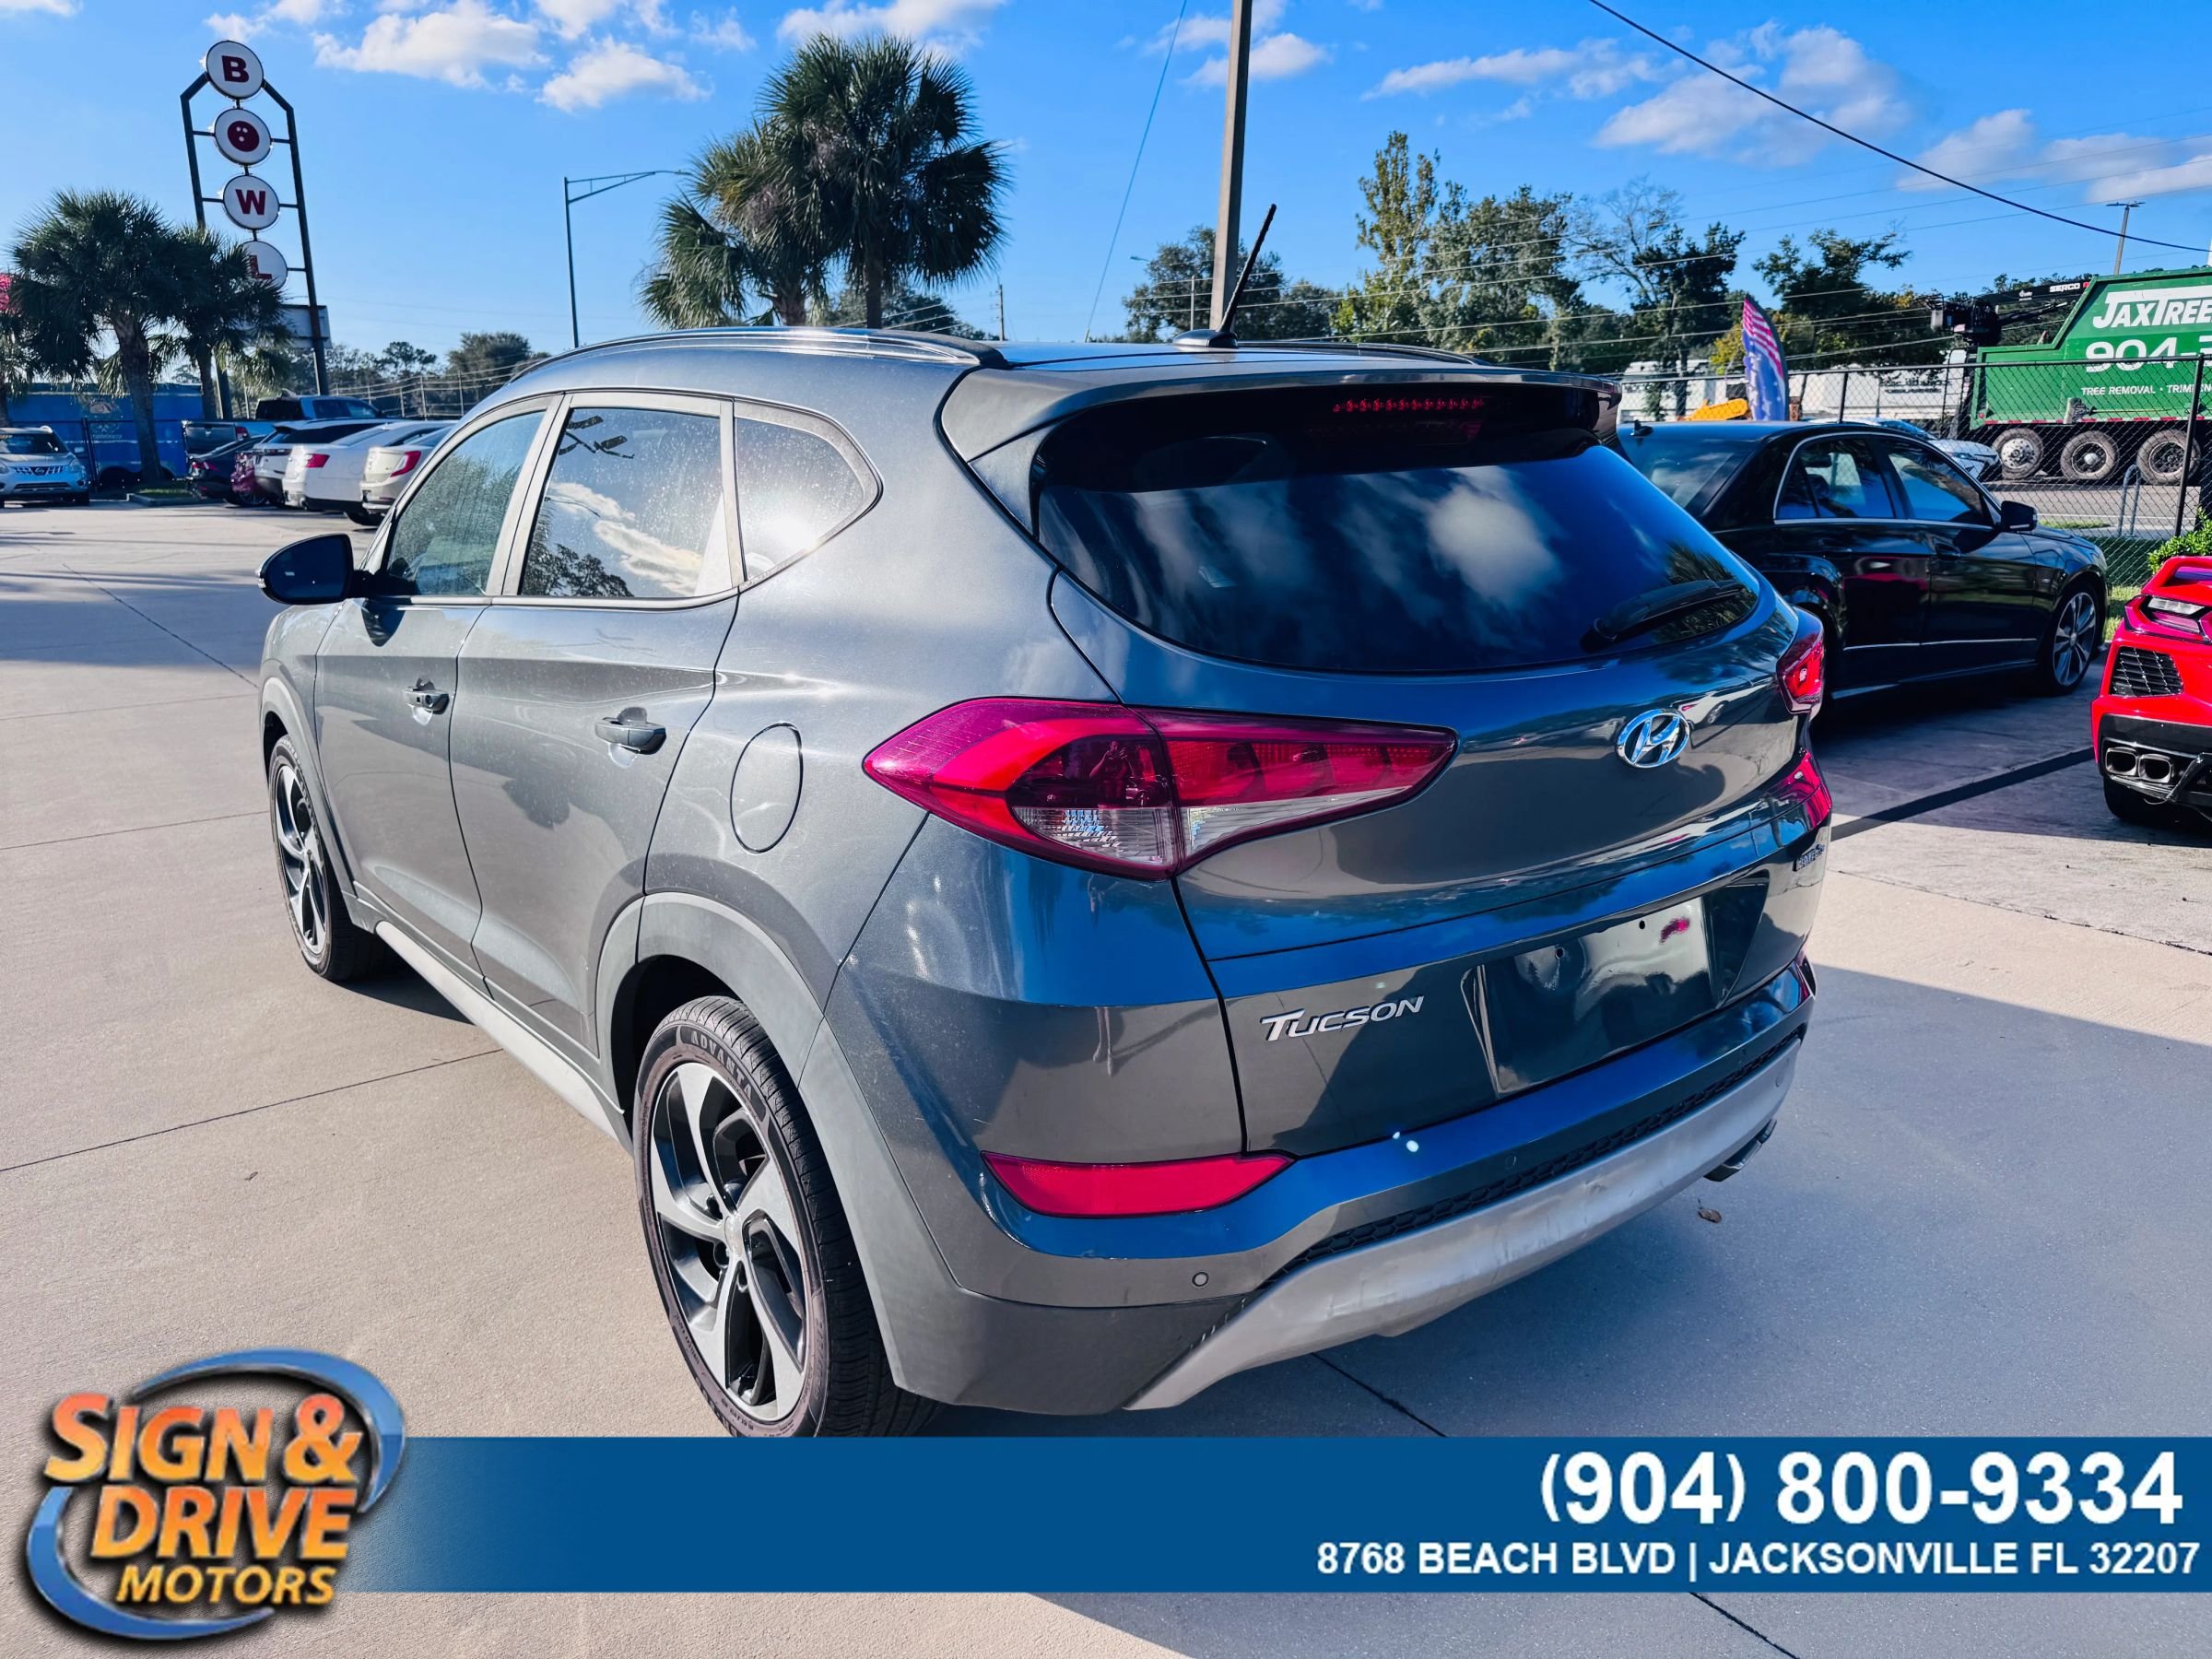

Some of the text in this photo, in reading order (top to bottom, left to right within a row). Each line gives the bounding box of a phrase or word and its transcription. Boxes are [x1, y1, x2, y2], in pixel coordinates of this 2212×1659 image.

[2080, 386, 2106, 396] TREE
[2108, 384, 2156, 395] REMOVAL
[1260, 995, 1425, 1041] TUCSON
[689, 1030, 753, 1100] ADVANTA
